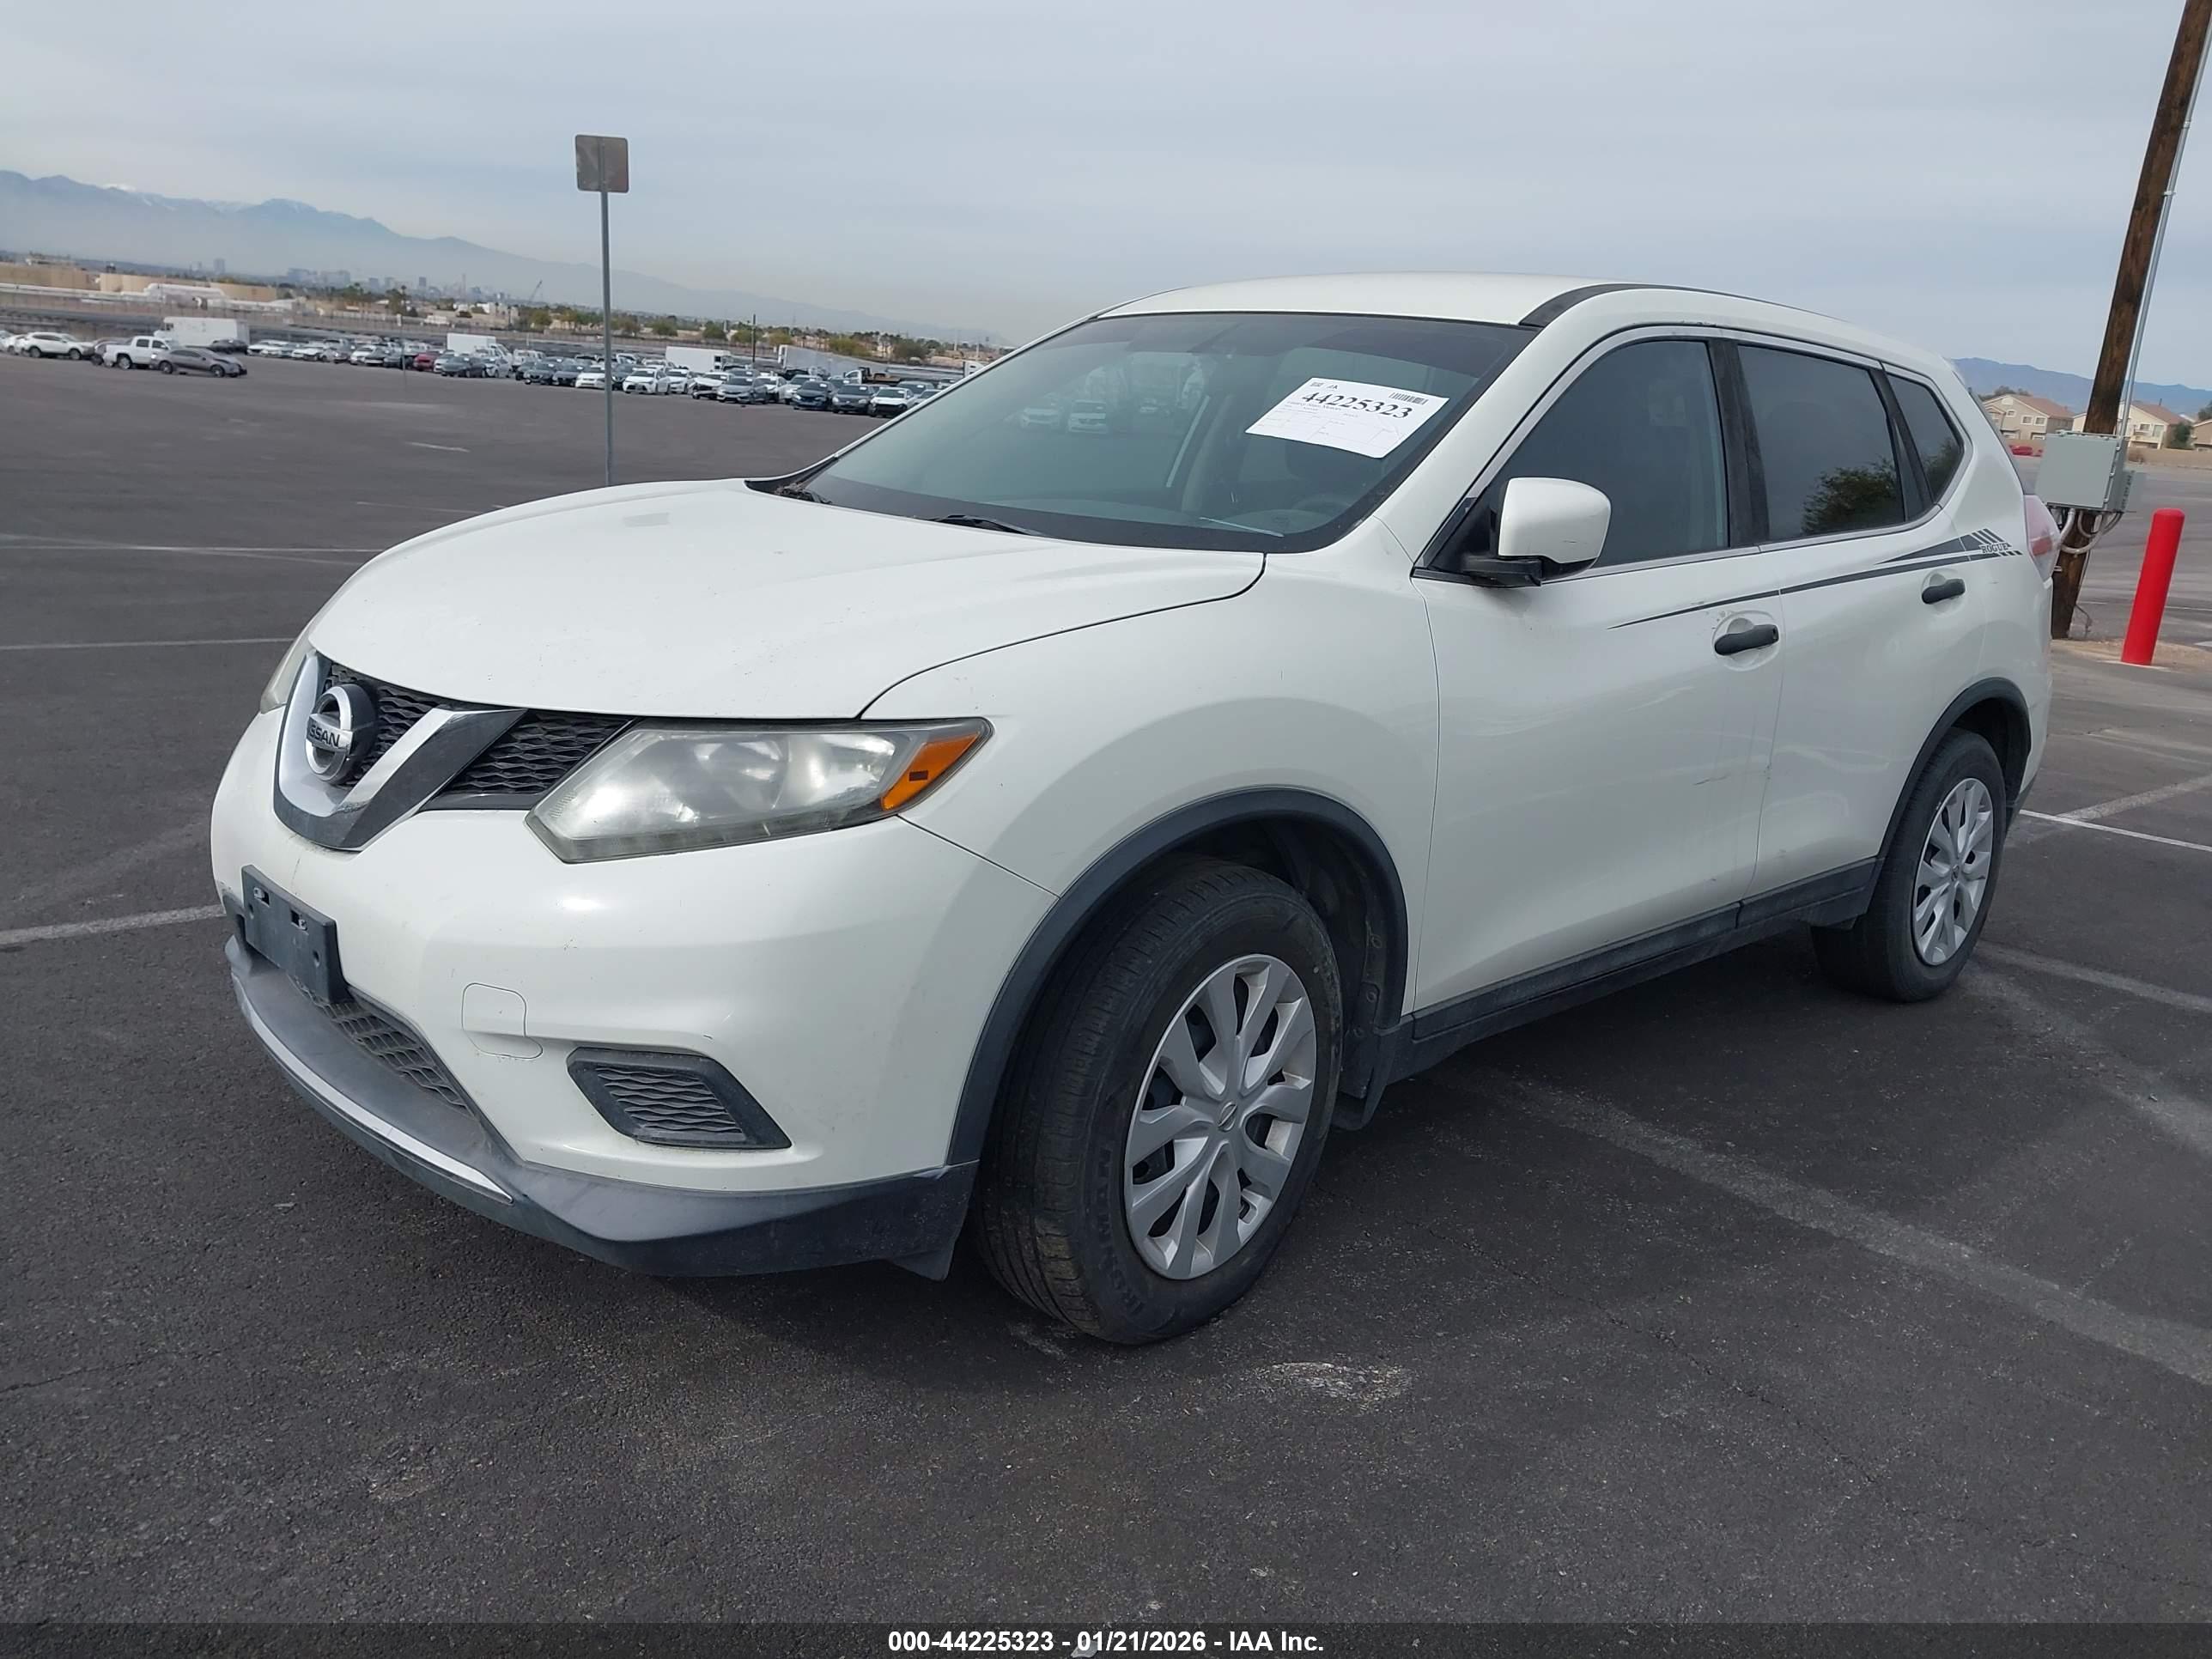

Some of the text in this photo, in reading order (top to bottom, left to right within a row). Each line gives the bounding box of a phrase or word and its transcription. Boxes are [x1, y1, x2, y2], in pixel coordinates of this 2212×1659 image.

[1301, 392, 1413, 419] 44225323
[1978, 542, 2009, 554] ROGUE
[309, 724, 340, 748] SSAN
